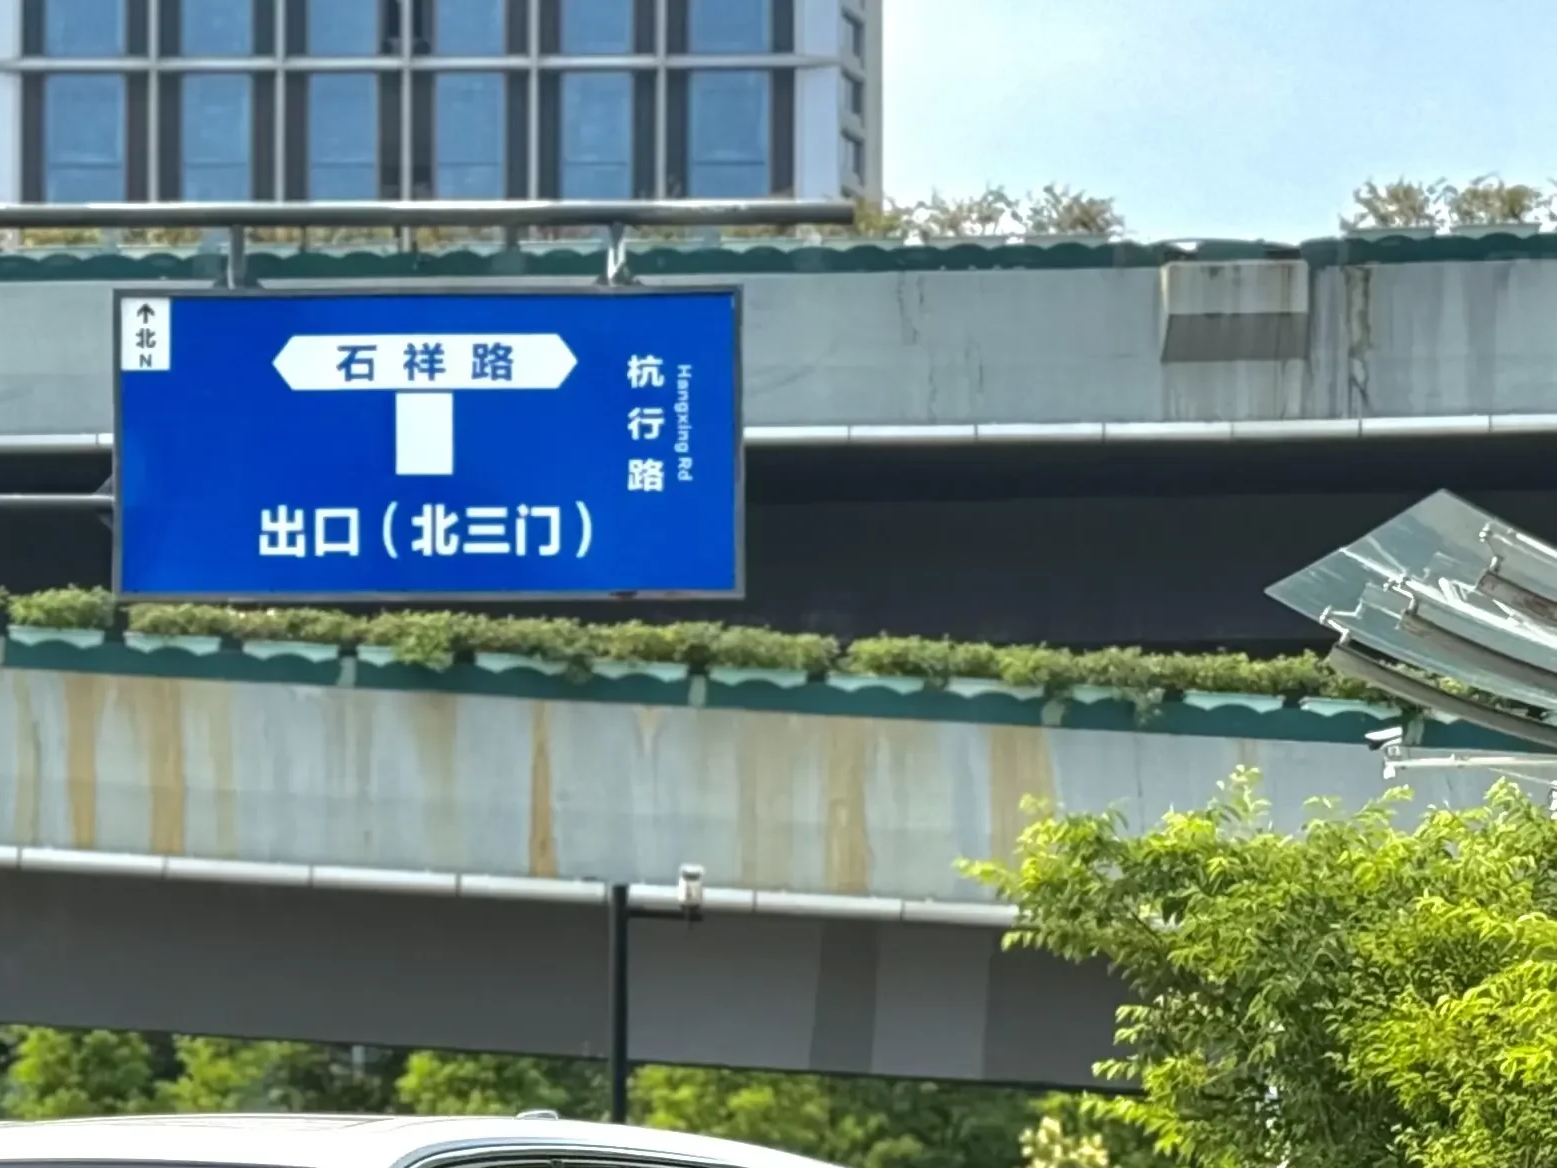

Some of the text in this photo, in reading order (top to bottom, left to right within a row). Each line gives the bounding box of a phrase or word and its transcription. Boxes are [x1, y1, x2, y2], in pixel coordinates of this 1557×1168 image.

[135, 328, 156, 349] 北
[139, 354, 152, 368] N
[336, 342, 514, 382] 石祥路
[627, 354, 665, 492] 杭行路
[674, 364, 693, 481] Hangxing Rd
[259, 501, 592, 558] 出口（北三门）
